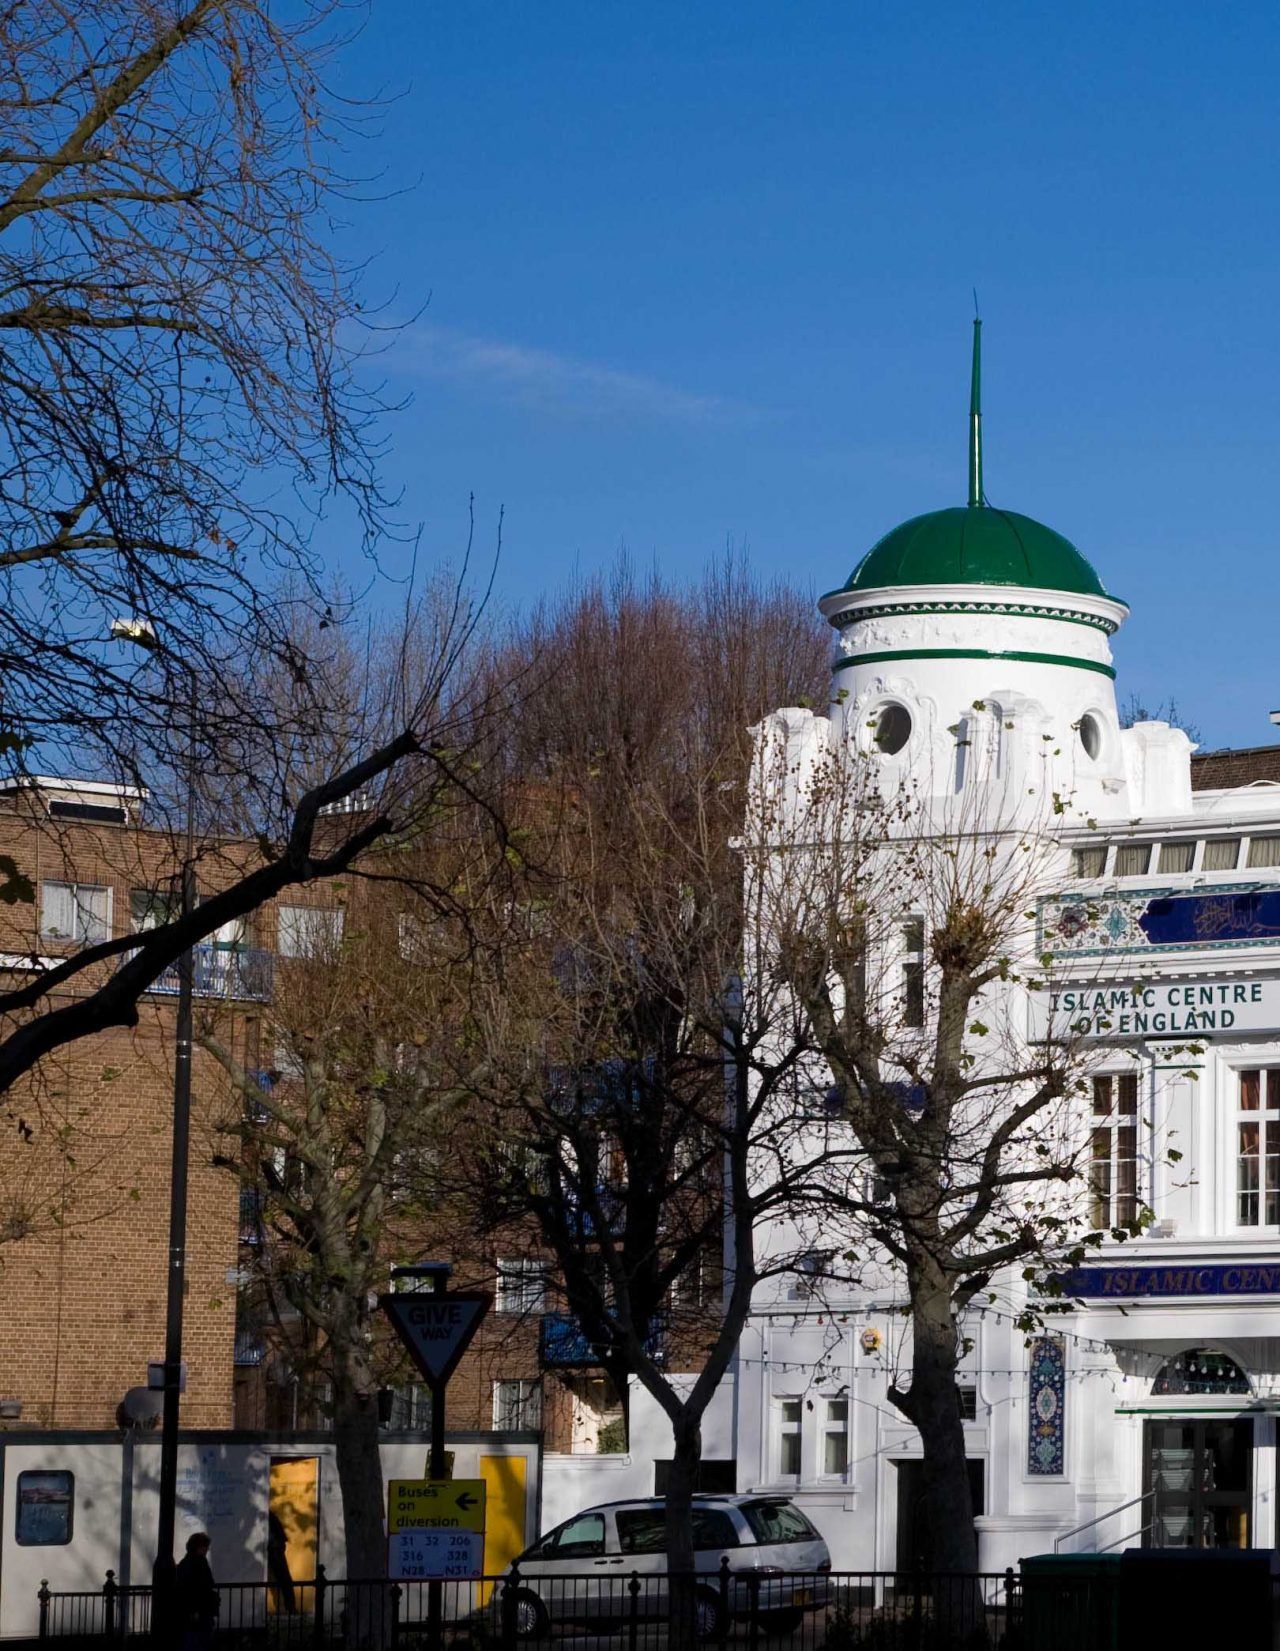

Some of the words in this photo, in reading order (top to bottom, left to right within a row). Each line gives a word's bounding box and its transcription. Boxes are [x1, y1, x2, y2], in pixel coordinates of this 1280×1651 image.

[1051, 988, 1155, 1012] ISLAMIC
[1168, 984, 1262, 1007] CENTRE
[1078, 1015, 1108, 1036] OF
[1119, 1010, 1235, 1033] ENGLAND
[1103, 1269, 1213, 1293] ISLAMIC
[408, 1304, 463, 1325] GIVE
[421, 1326, 454, 1341] WAY
[398, 1486, 438, 1498] Buses
[398, 1502, 415, 1511] on
[396, 1515, 459, 1528] diversion
[401, 1536, 414, 1546] 31
[425, 1536, 439, 1546] 32
